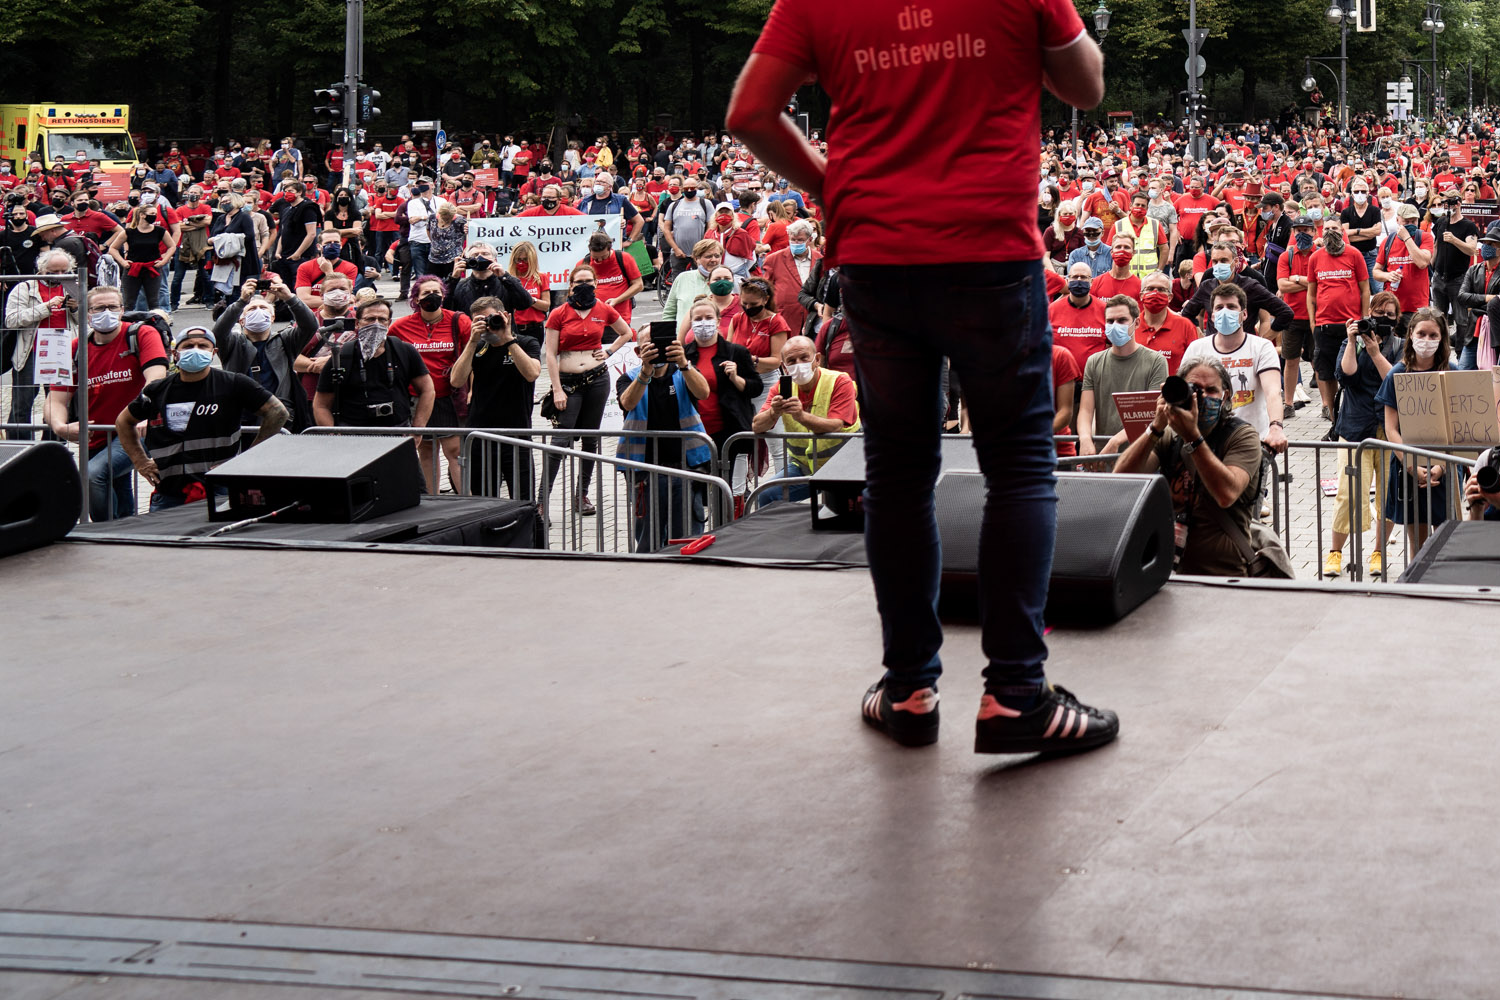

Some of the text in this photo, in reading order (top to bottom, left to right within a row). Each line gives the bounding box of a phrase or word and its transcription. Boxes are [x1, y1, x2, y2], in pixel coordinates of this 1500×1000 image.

[898, 4, 933, 31] die
[853, 33, 986, 74] Pleitewelle
[476, 225, 587, 239] Bad & Spuncer
[538, 241, 572, 253] GbR
[1396, 374, 1437, 392] BRING
[196, 404, 218, 416] 019
[1398, 394, 1490, 416] CONC ERTS
[1453, 420, 1494, 443] BACK
